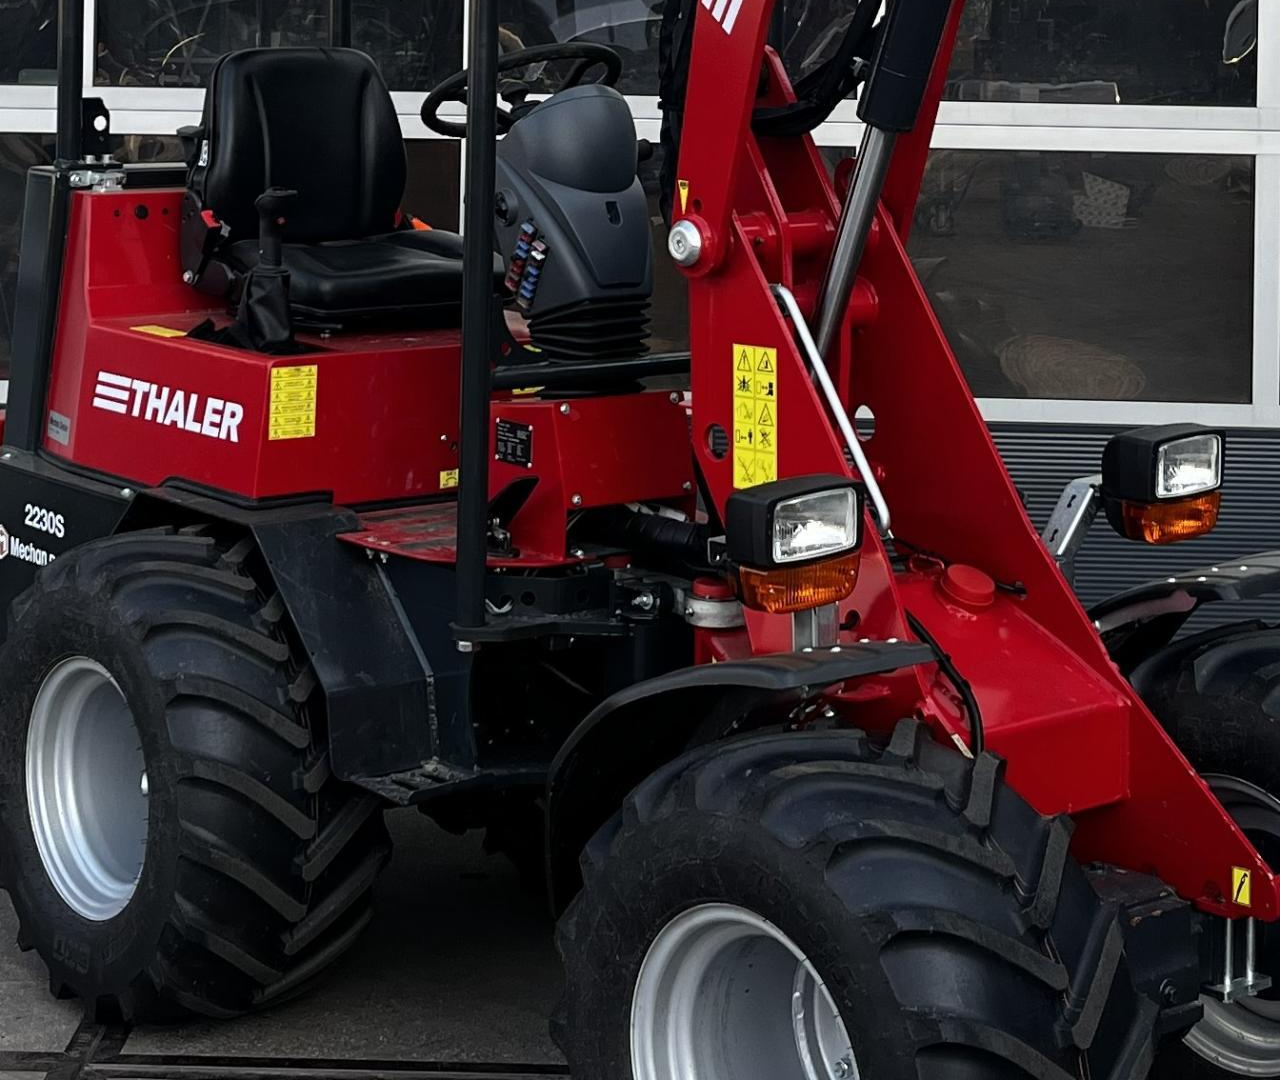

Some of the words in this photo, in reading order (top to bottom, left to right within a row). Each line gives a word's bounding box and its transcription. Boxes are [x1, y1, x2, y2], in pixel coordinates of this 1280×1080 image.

[131, 378, 244, 443] THALER
[24, 503, 65, 538] 2230S
[10, 535, 48, 566] Mechan
